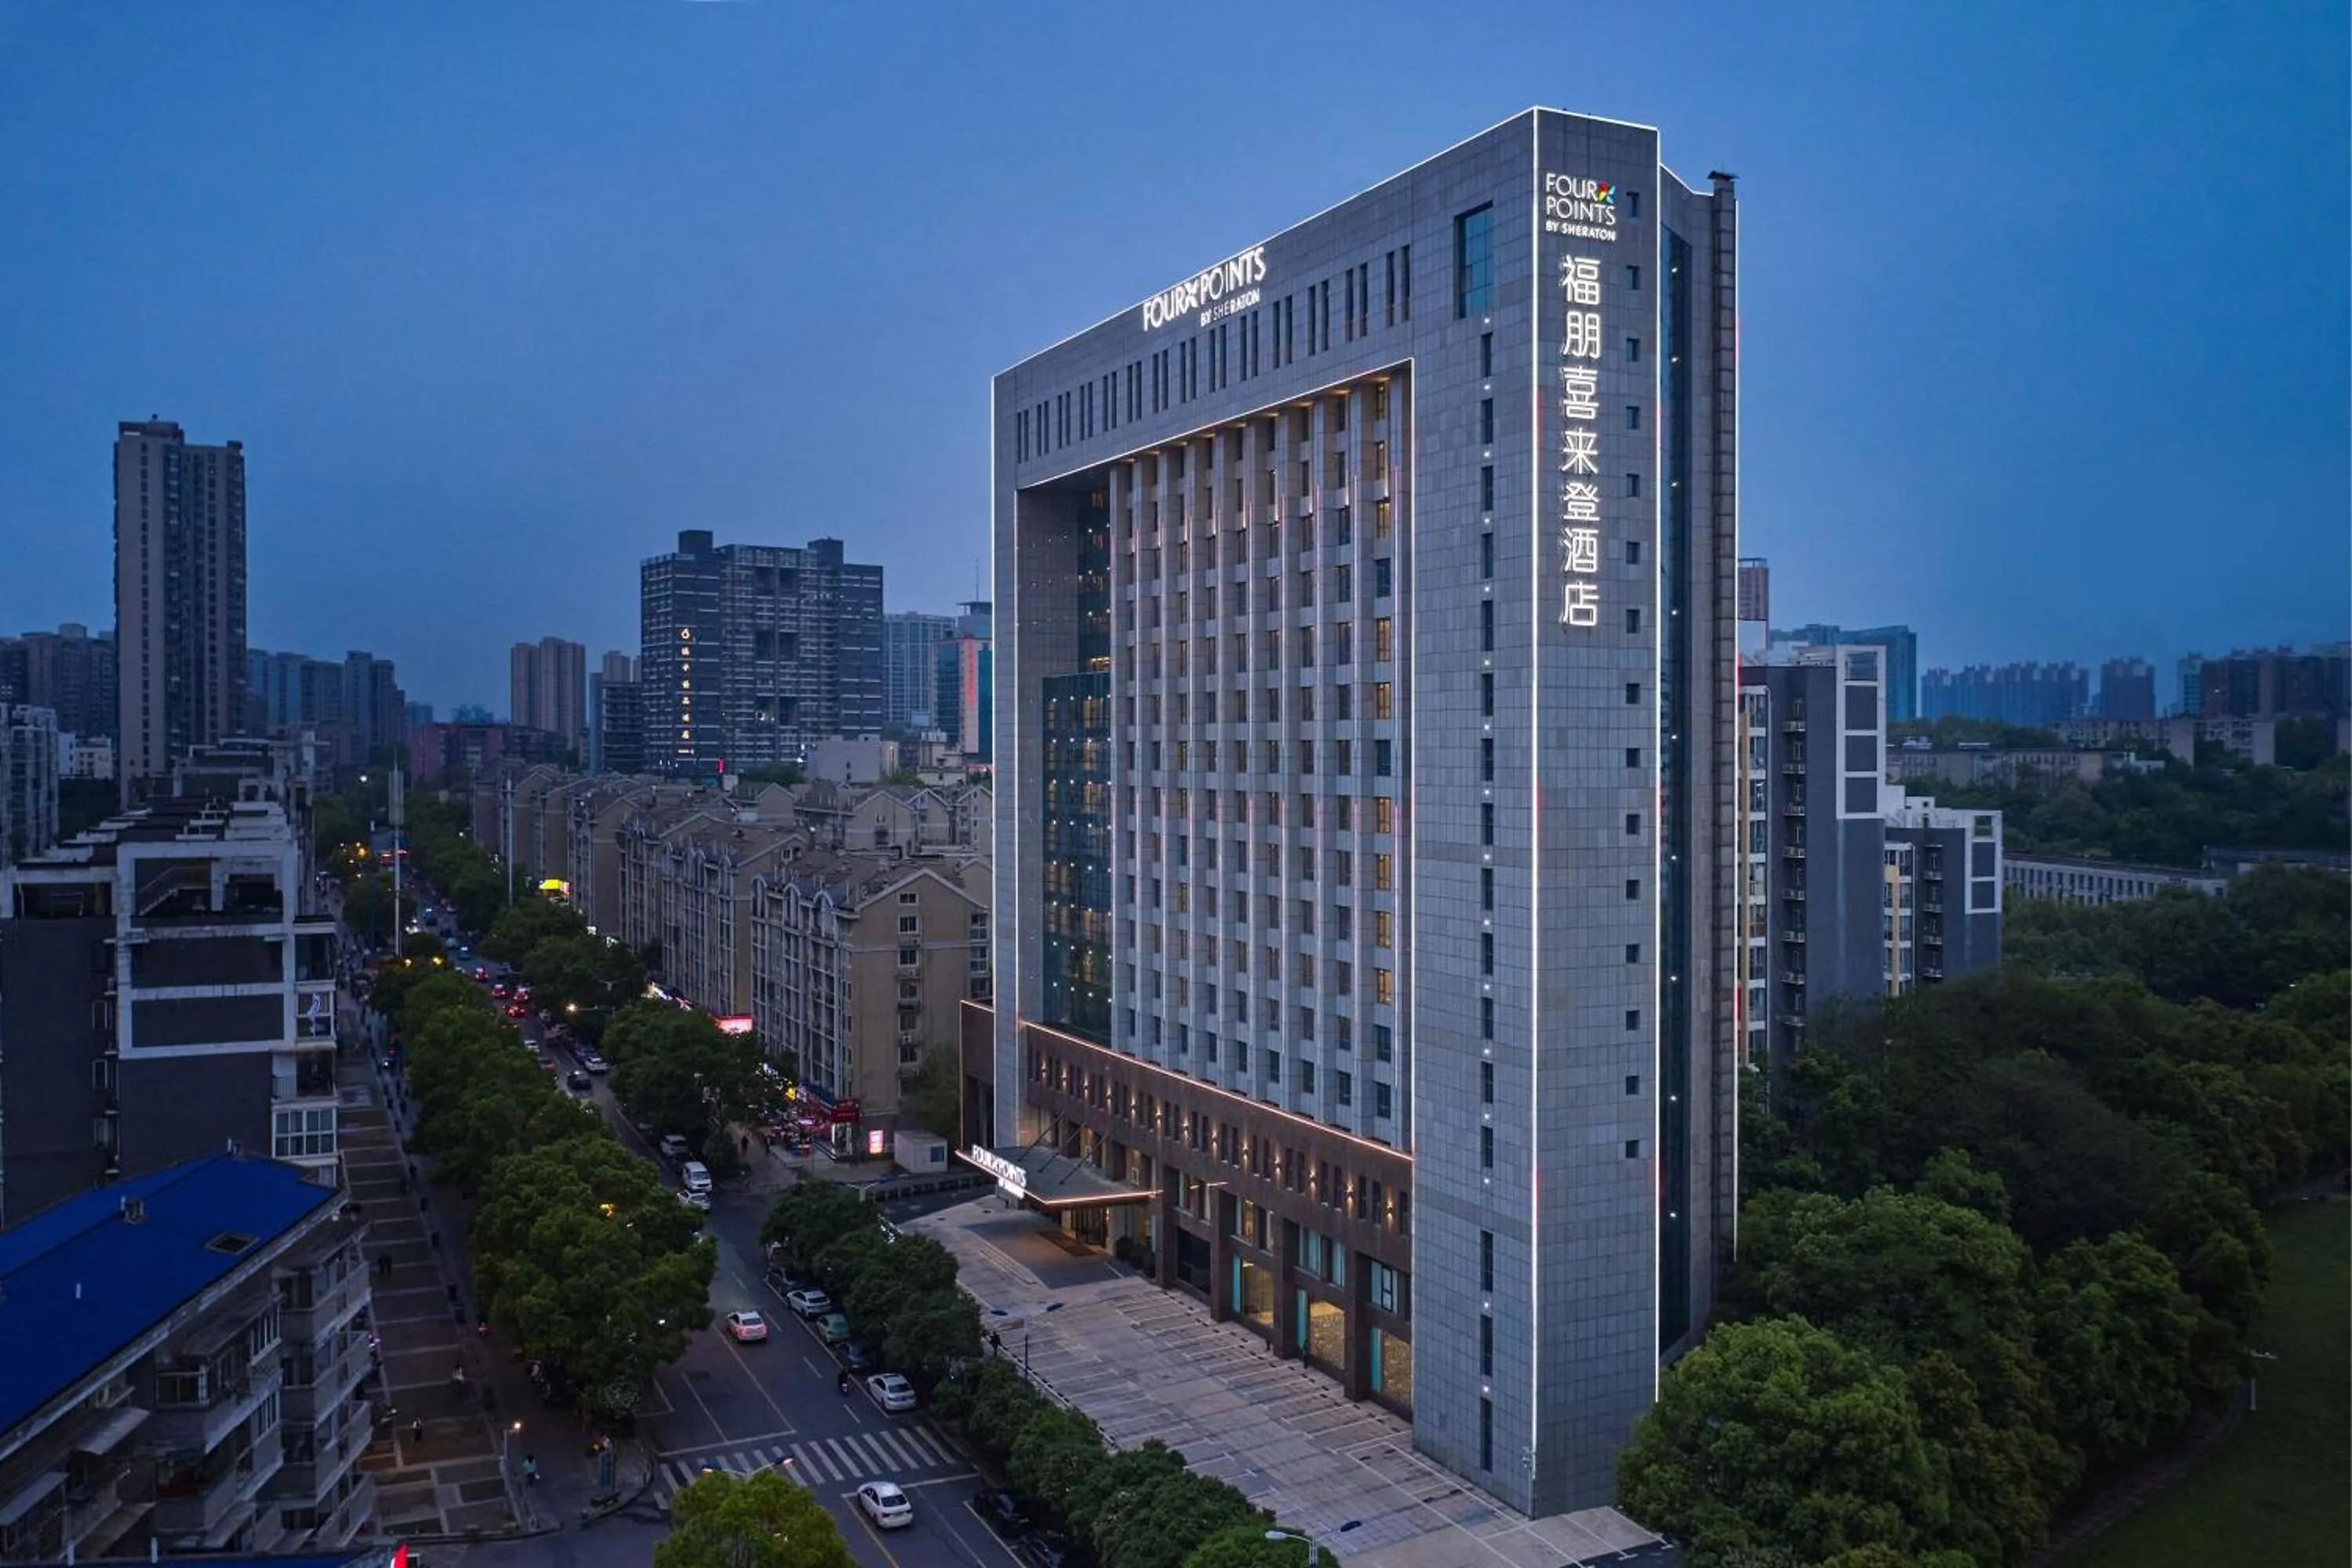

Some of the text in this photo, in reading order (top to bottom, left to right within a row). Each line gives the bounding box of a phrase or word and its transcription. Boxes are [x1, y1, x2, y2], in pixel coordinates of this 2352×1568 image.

[1545, 173, 1599, 201] FOUR
[1545, 196, 1617, 226] POINTS
[1545, 220, 1617, 241] BY SHERATON
[1142, 247, 1267, 332] FOUR POINTS
[1200, 289, 1260, 328] BY SHERATON
[1561, 254, 1601, 626] 福朋喜来登酒店
